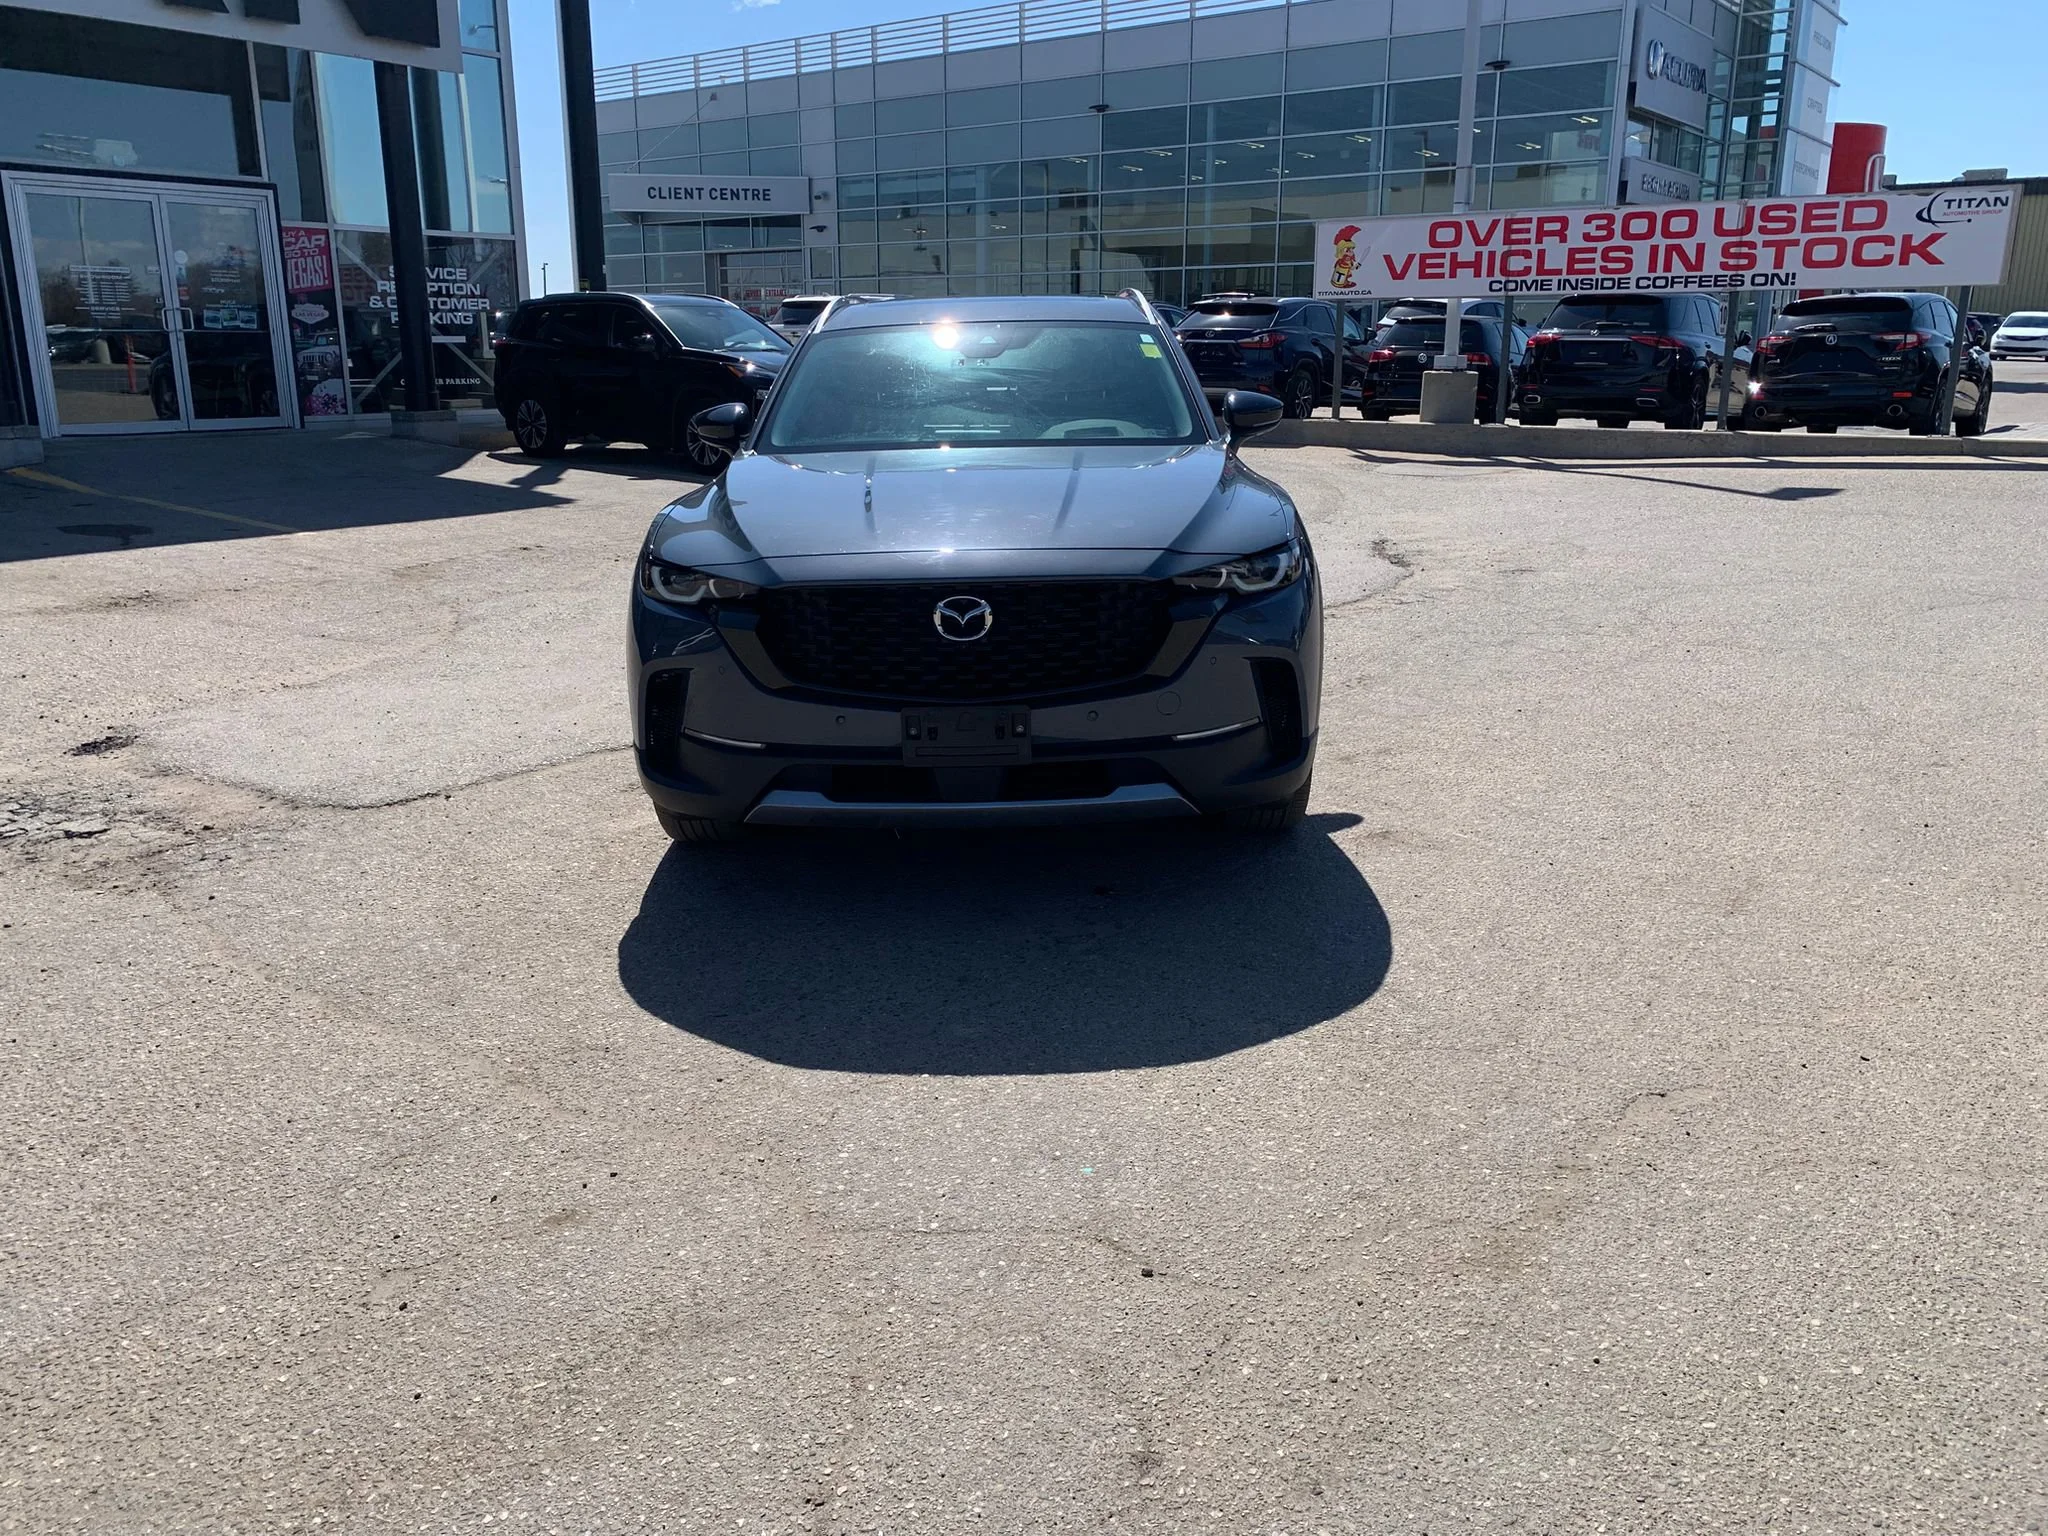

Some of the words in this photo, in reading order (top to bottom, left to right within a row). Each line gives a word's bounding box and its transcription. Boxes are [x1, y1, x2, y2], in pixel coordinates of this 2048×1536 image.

[1661, 52, 1707, 94] ACURA
[647, 186, 704, 200] CLIENT
[708, 187, 771, 201] CENTRE
[1943, 196, 2009, 210] TITAN
[1428, 215, 1569, 249] OVER
[1582, 209, 1698, 243] 300
[1713, 199, 1888, 238] USED
[282, 234, 326, 250] CAR
[285, 249, 301, 259] GO
[302, 248, 319, 256] TO
[1383, 245, 1634, 281] VEHICLES
[1647, 242, 1706, 274] IN
[1719, 232, 1948, 272] STOCK
[1335, 271, 1345, 283] T
[1488, 278, 1553, 293] COME
[1557, 276, 1631, 292] INSIDE
[1635, 272, 1745, 290] COFFEES
[1750, 272, 1797, 288] ON!
[369, 296, 385, 308] &
[387, 296, 490, 310] CTOMER
[391, 311, 473, 325] PKING
